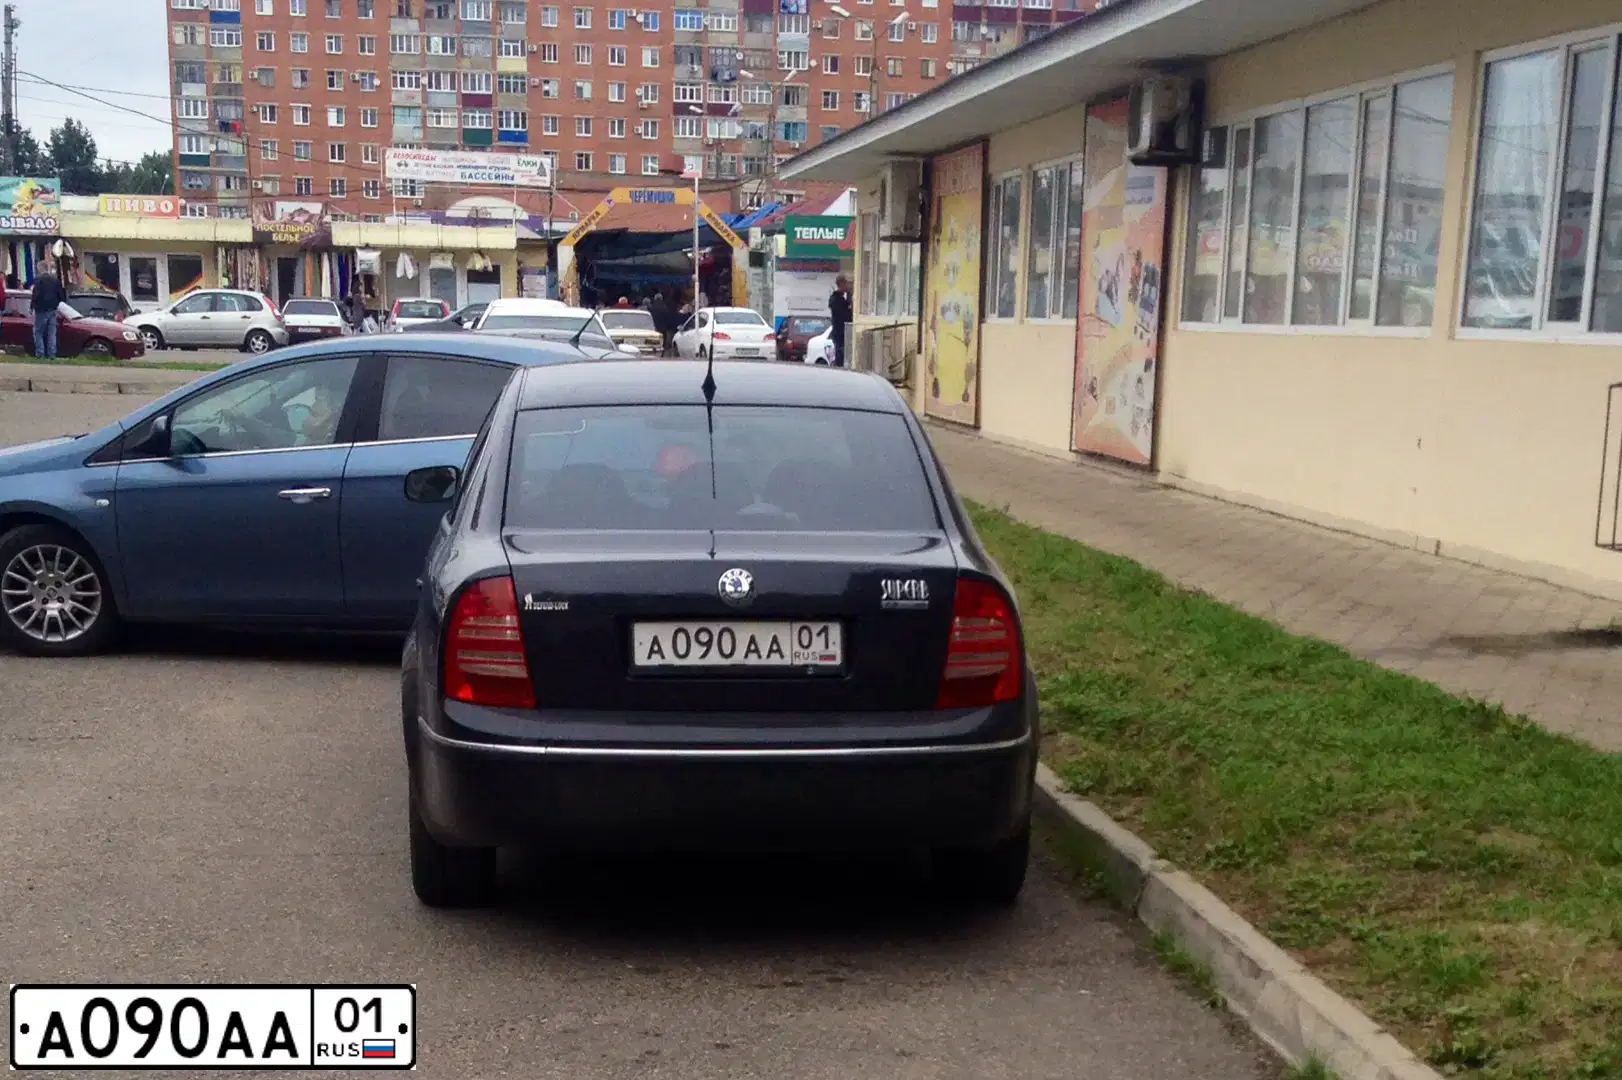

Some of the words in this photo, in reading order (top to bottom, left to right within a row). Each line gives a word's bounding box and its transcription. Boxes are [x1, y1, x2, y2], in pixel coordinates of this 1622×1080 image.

[460, 172, 515, 181] БАССЕЙНЫ
[106, 199, 174, 214] ПИВО
[794, 227, 845, 240] ТЕПЛЫЕ
[881, 579, 930, 600] SUPERB
[798, 625, 829, 649] 01
[794, 651, 818, 661] RUS
